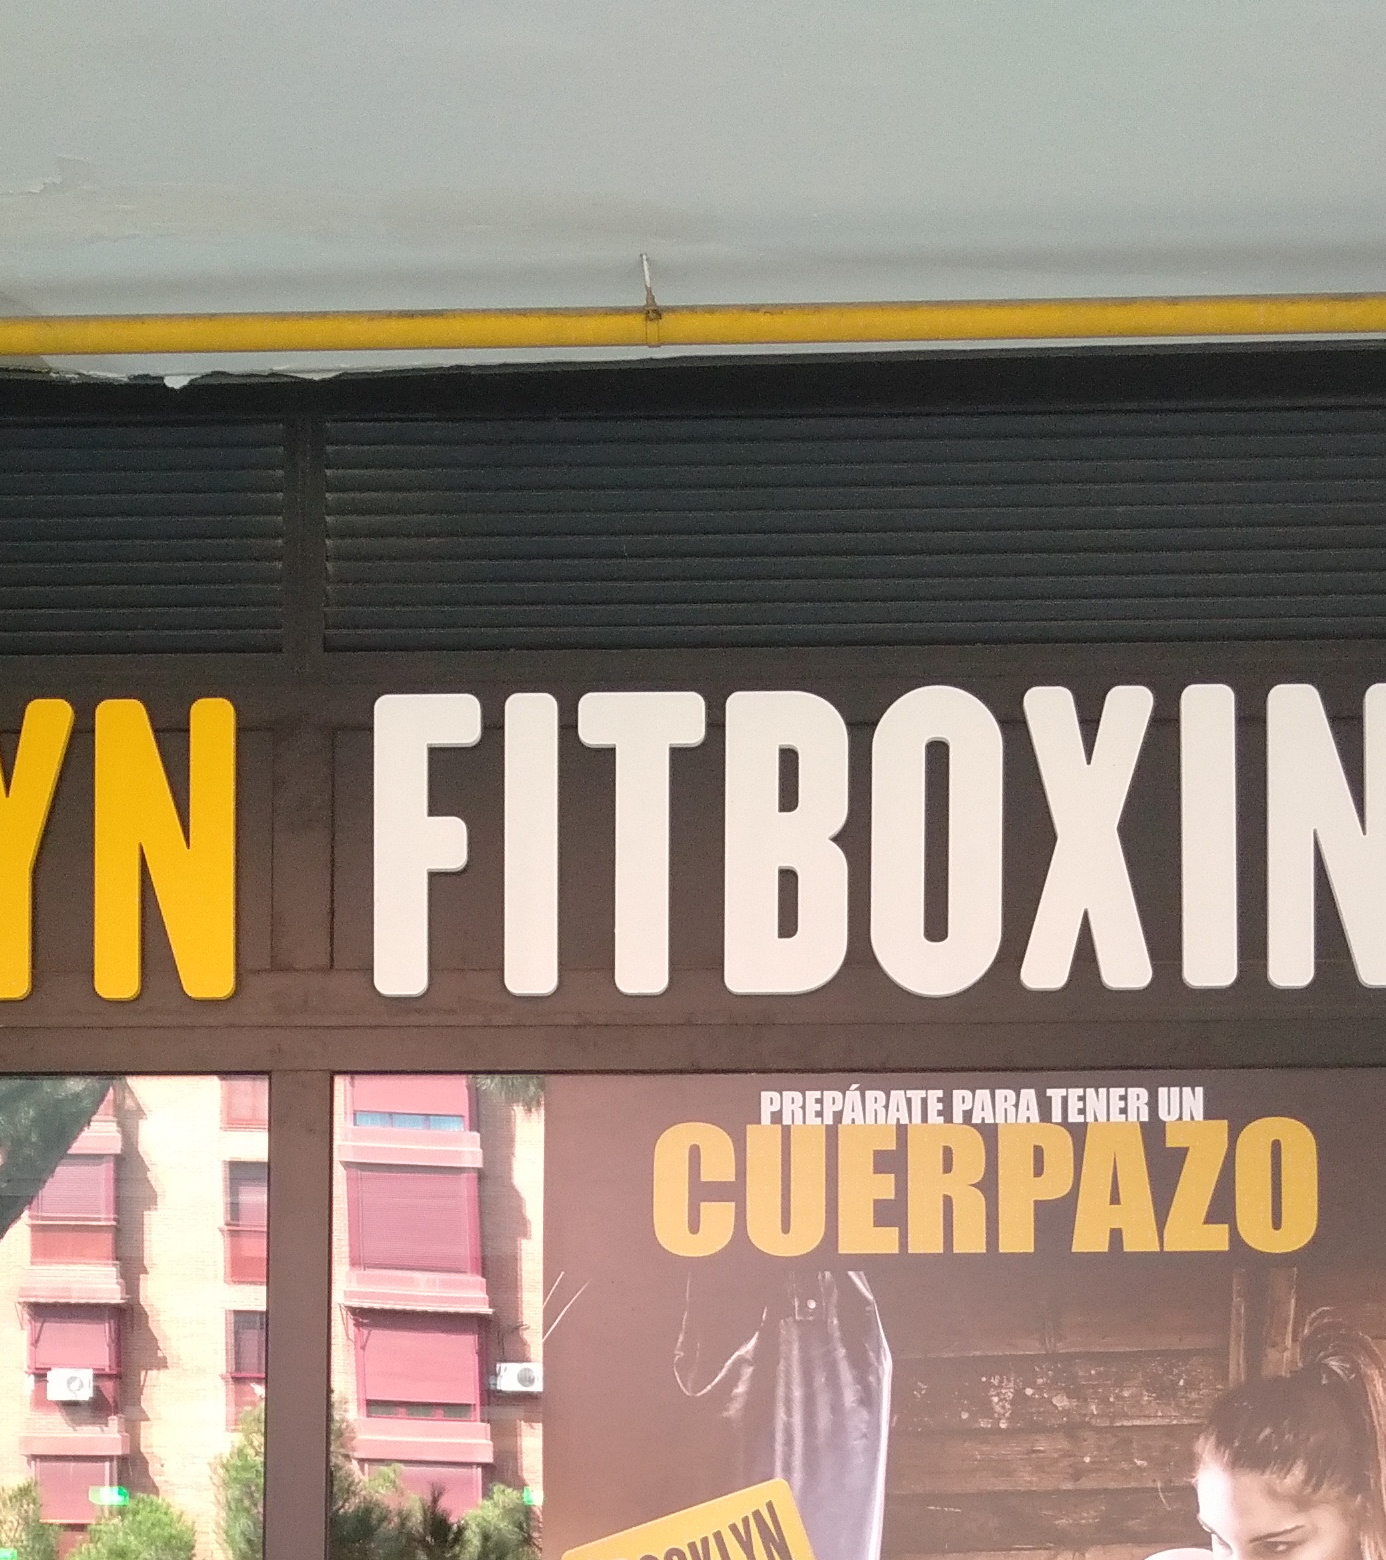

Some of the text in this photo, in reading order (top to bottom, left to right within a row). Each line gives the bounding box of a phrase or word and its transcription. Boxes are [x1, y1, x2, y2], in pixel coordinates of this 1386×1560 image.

[760, 1083, 1205, 1125] PREPÁRATE PARA TENER UN
[652, 1116, 1319, 1258] CUERPAZO
